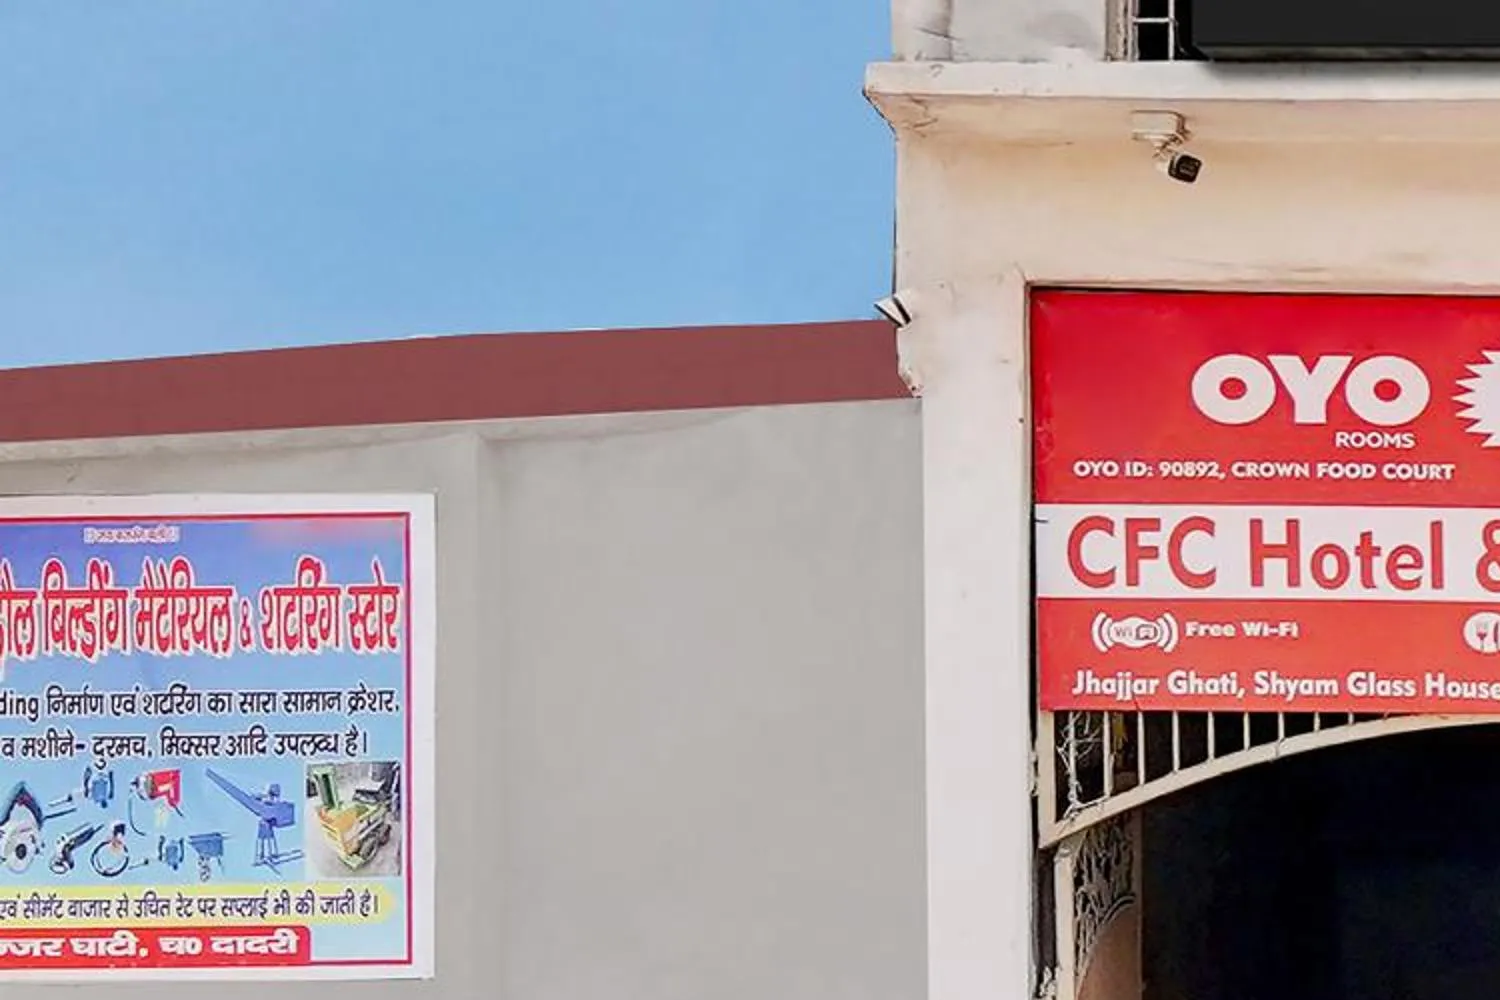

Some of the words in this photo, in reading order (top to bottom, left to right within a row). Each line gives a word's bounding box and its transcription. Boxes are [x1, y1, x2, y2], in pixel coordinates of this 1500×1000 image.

[1191, 353, 1431, 426] OYO
[1334, 430, 1416, 449] ROOMS
[1072, 461, 1119, 478] OYO
[1124, 461, 1154, 479] ID:
[1158, 461, 1225, 481] 90892,
[1231, 462, 1311, 479] CROWN
[1316, 462, 1377, 480] FOOD
[1382, 462, 1456, 481] COURT
[1067, 515, 1217, 589] CFC
[1248, 517, 1444, 591] Hotel
[347, 561, 400, 650] स्टोर
[1184, 621, 1236, 637] Free
[1071, 670, 1160, 700] Jhajjar
[1166, 670, 1245, 698] Ghati,
[1254, 671, 1338, 700] Shyam
[1347, 671, 1416, 697] Glass
[46, 685, 105, 716] निर्माण
[110, 685, 141, 717] एवं
[207, 692, 233, 714] का
[239, 692, 277, 714] सारा
[282, 691, 342, 714] सामान
[226, 725, 268, 757] आदि
[115, 893, 129, 919] से
[175, 892, 194, 919] रेट
[197, 897, 217, 917] पर
[295, 889, 314, 916] की
[320, 889, 355, 916] जाती
[209, 928, 300, 955] दादरी
